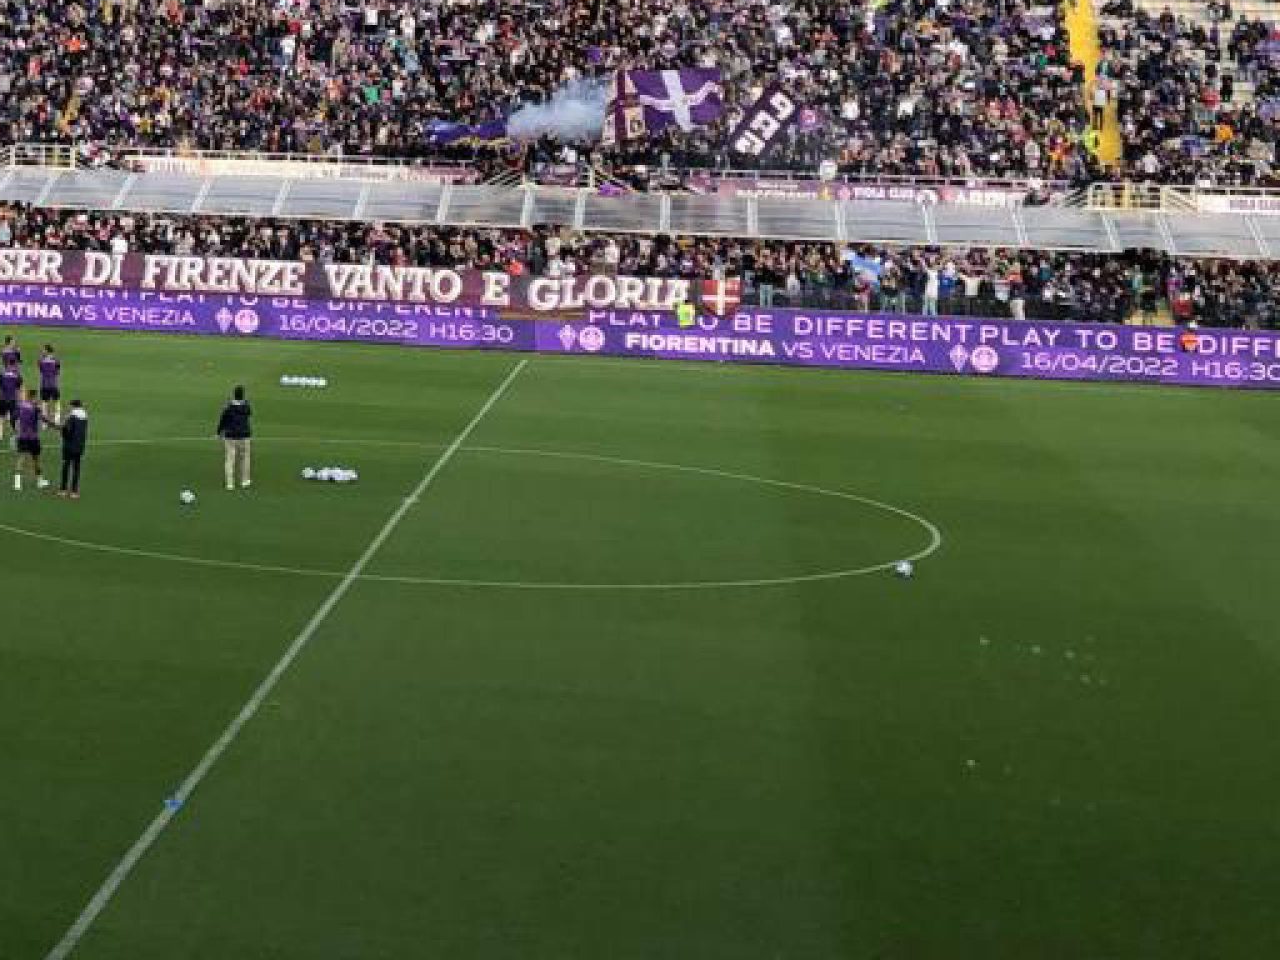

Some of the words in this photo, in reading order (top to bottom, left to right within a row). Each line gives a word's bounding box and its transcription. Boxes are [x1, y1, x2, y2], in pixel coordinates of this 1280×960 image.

[140, 254, 306, 295] FIRENZE
[324, 262, 463, 304] VANTO
[480, 271, 511, 306] E
[528, 274, 691, 311] GLORIA
[70, 304, 96, 321] VS
[103, 305, 196, 326] VENEZIA
[279, 314, 419, 338] 16/04/2022
[734, 314, 774, 333] BE
[794, 316, 974, 343] DIFFERENT
[625, 331, 776, 356] FIORENTINA
[782, 341, 815, 359] VS
[820, 342, 926, 365] VENEZIA
[980, 324, 1061, 346] PLAY
[1075, 330, 1118, 350] TO
[1134, 332, 1176, 352] BE
[1198, 334, 1280, 360] DIFF
[1021, 351, 1180, 376] 16/04/2022
